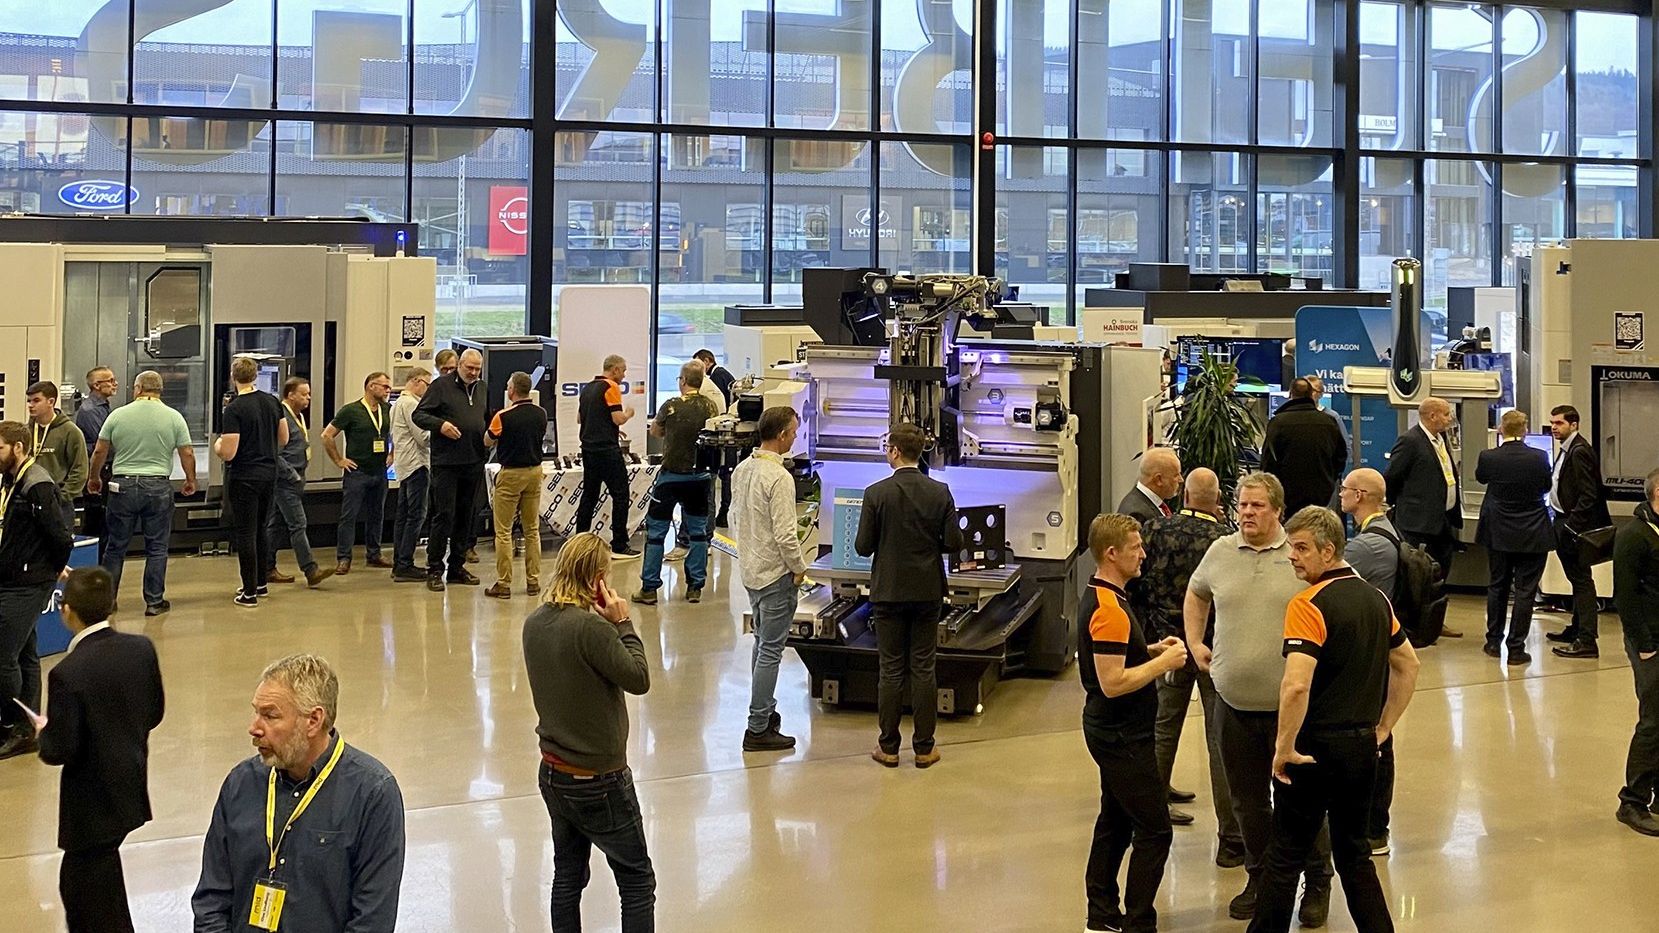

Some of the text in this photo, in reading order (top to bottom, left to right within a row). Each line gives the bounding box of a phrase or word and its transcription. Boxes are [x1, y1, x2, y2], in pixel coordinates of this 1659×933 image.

[74, 184, 124, 204] Ford
[498, 211, 527, 219] NISS
[848, 228, 897, 238] HYUDAI
[874, 282, 884, 291] 4
[1325, 343, 1360, 351] HEXAGON
[1315, 369, 1344, 380] Vi ka
[1608, 371, 1651, 380] OKUMA
[543, 494, 563, 521] ECO
